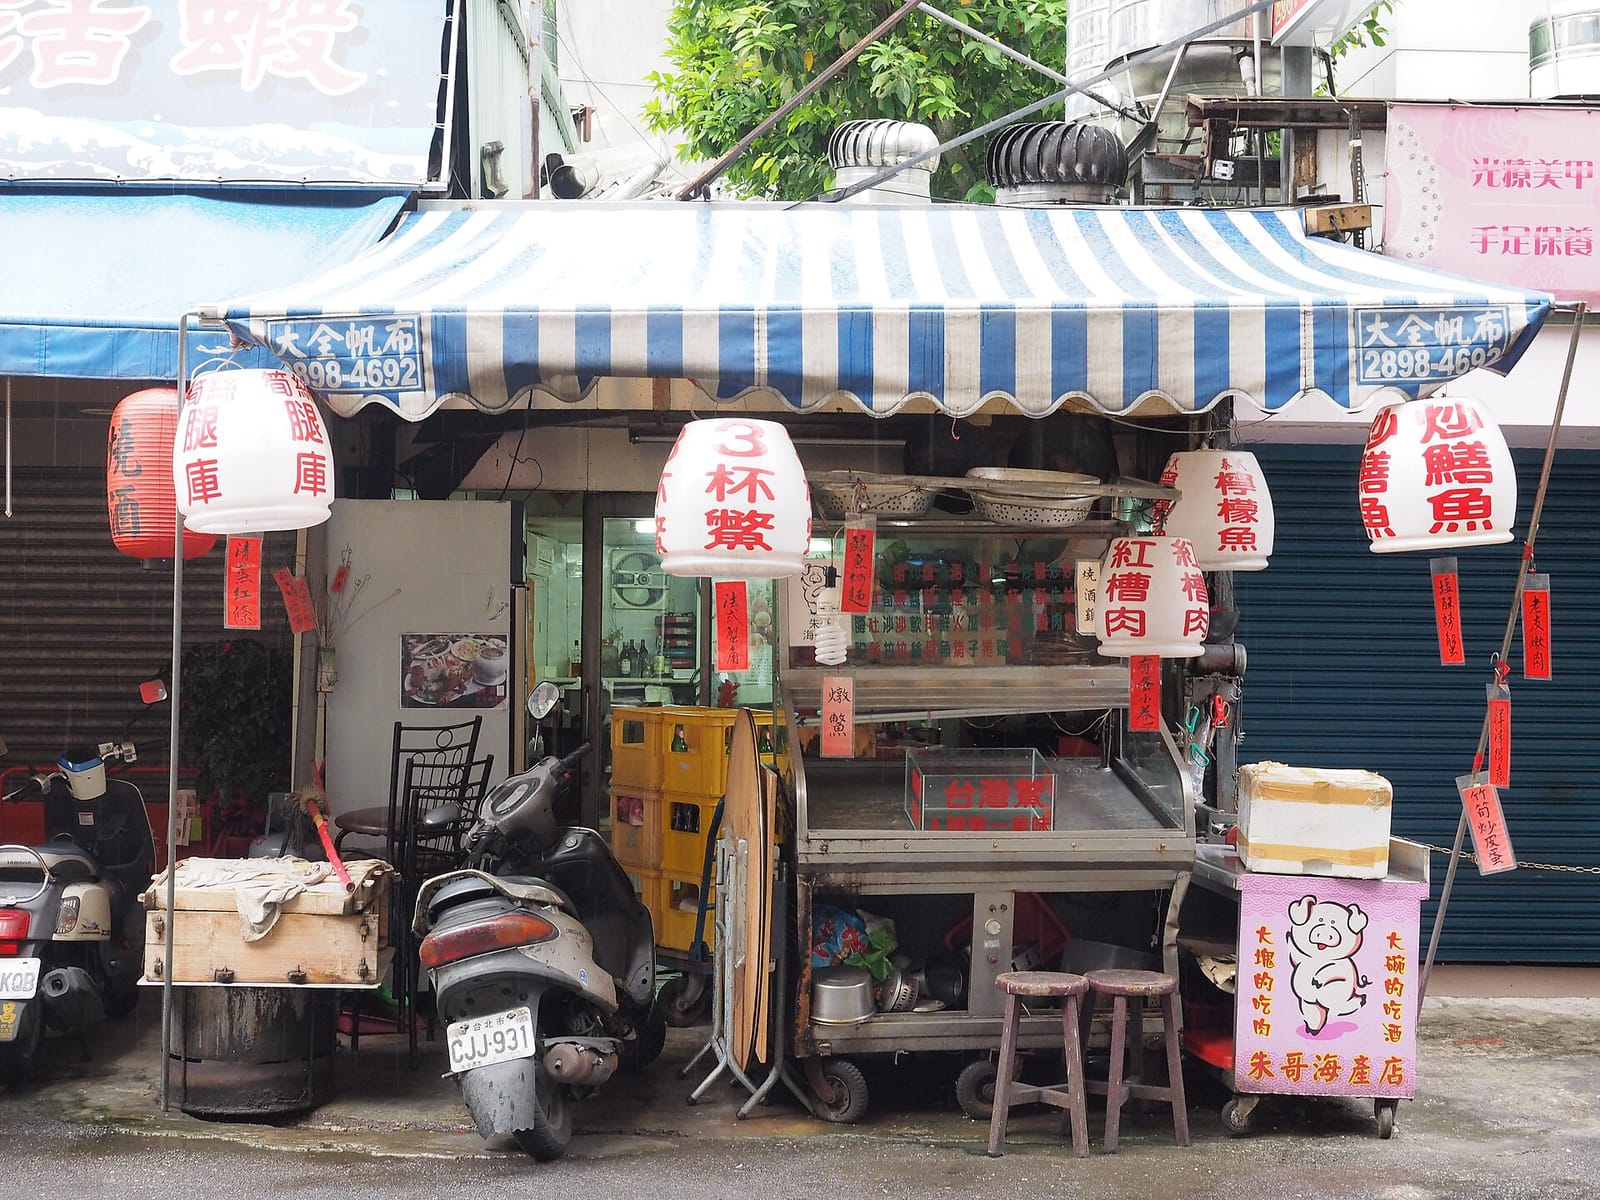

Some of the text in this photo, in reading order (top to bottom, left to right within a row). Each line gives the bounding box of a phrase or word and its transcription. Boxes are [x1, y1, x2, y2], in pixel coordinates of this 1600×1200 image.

[1470, 225, 1593, 256] 手足保養
[275, 321, 415, 359] 大全帆布
[1365, 312, 1503, 348] 大全帆布
[296, 359, 417, 388] 898-4692
[1419, 403, 1494, 534] 炒鱔魚
[1214, 471, 1259, 552] 檸檬魚
[1251, 925, 1276, 1038] 大塊的吃肉
[1382, 931, 1406, 1043] 大碗的吃酒
[1246, 1051, 1406, 1087] 朱哥海產店
